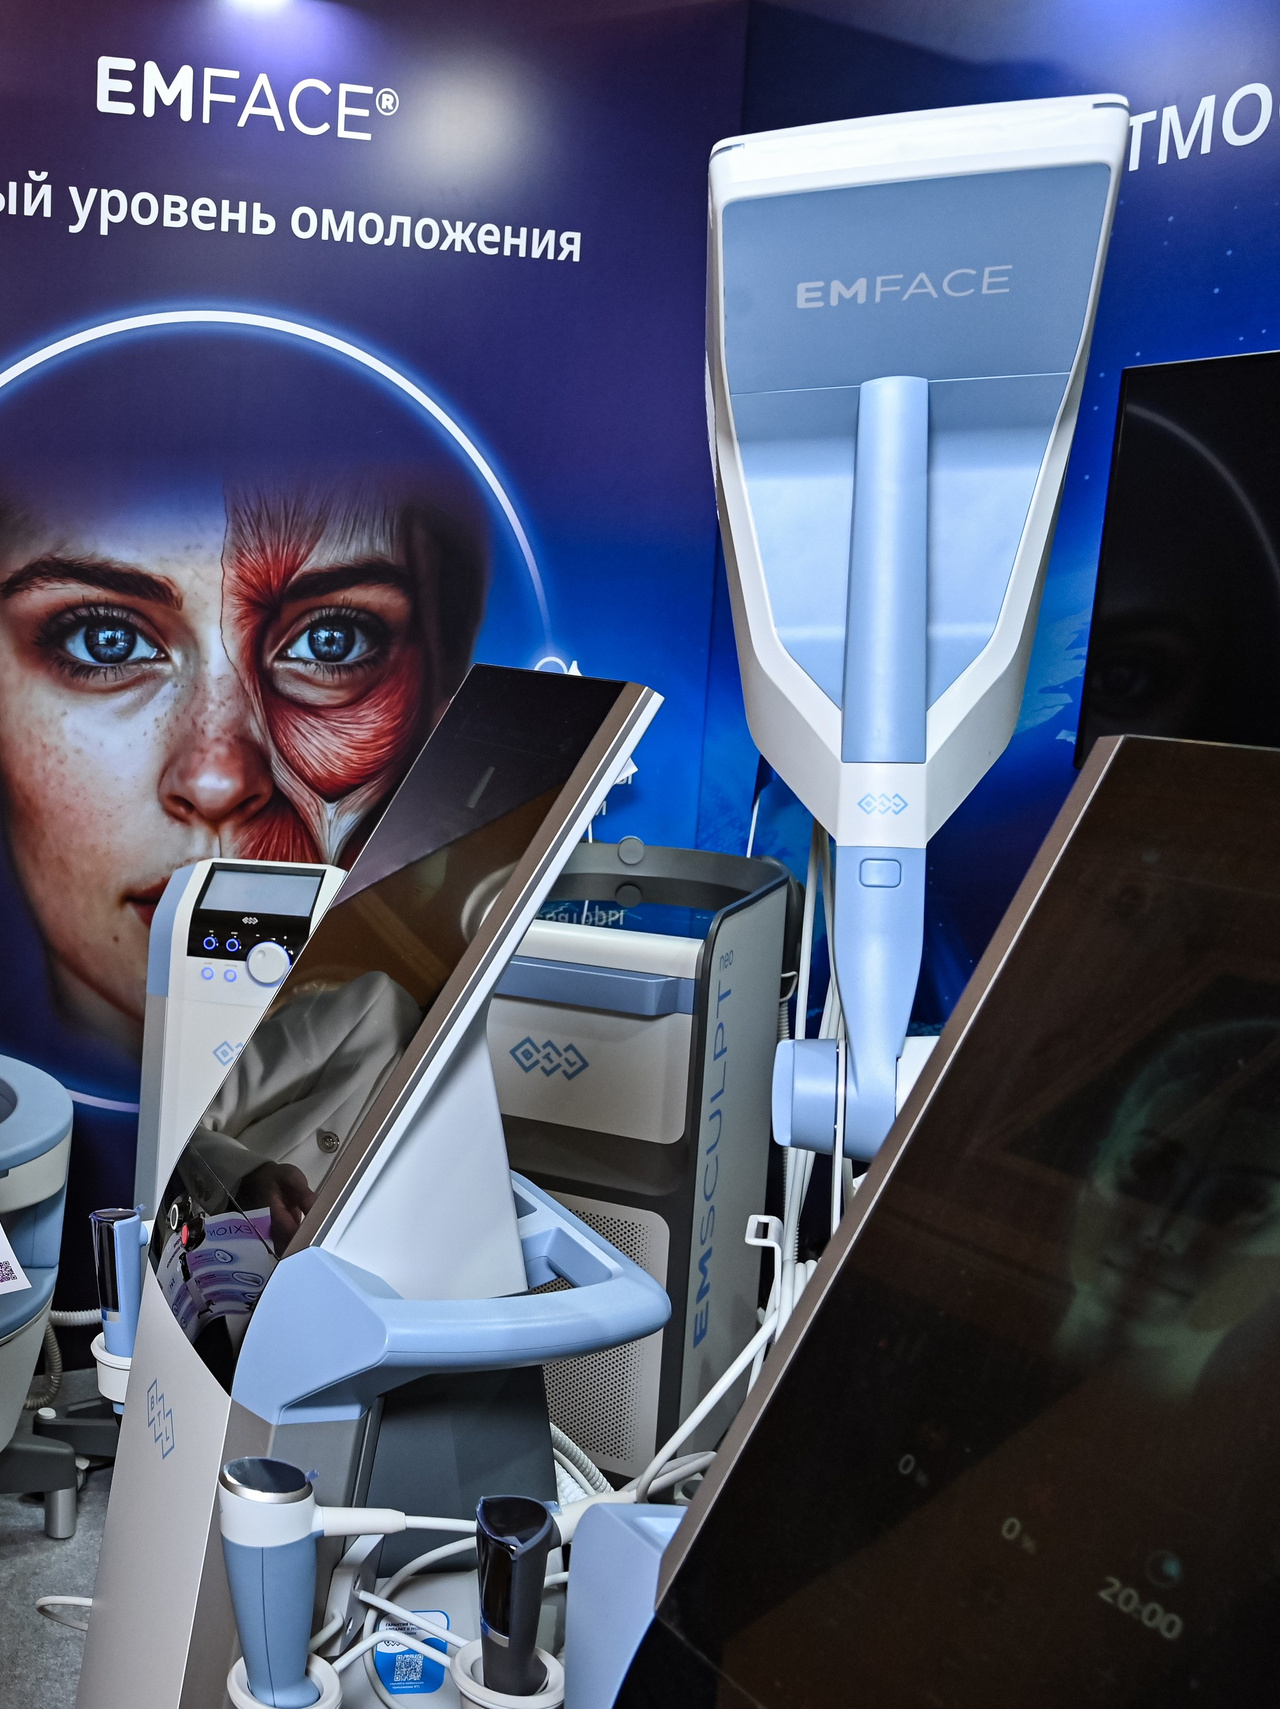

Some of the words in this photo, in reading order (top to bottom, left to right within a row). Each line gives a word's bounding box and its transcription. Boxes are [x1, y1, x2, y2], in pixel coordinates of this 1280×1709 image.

[96, 56, 400, 142] EMFACE®
[68, 185, 277, 237] уровень
[290, 206, 582, 263] омоложения
[796, 265, 1014, 310] EMFACE
[718, 949, 734, 973] neo
[693, 980, 732, 1349] EMSCULPT
[1097, 1575, 1184, 1641] 20:00
